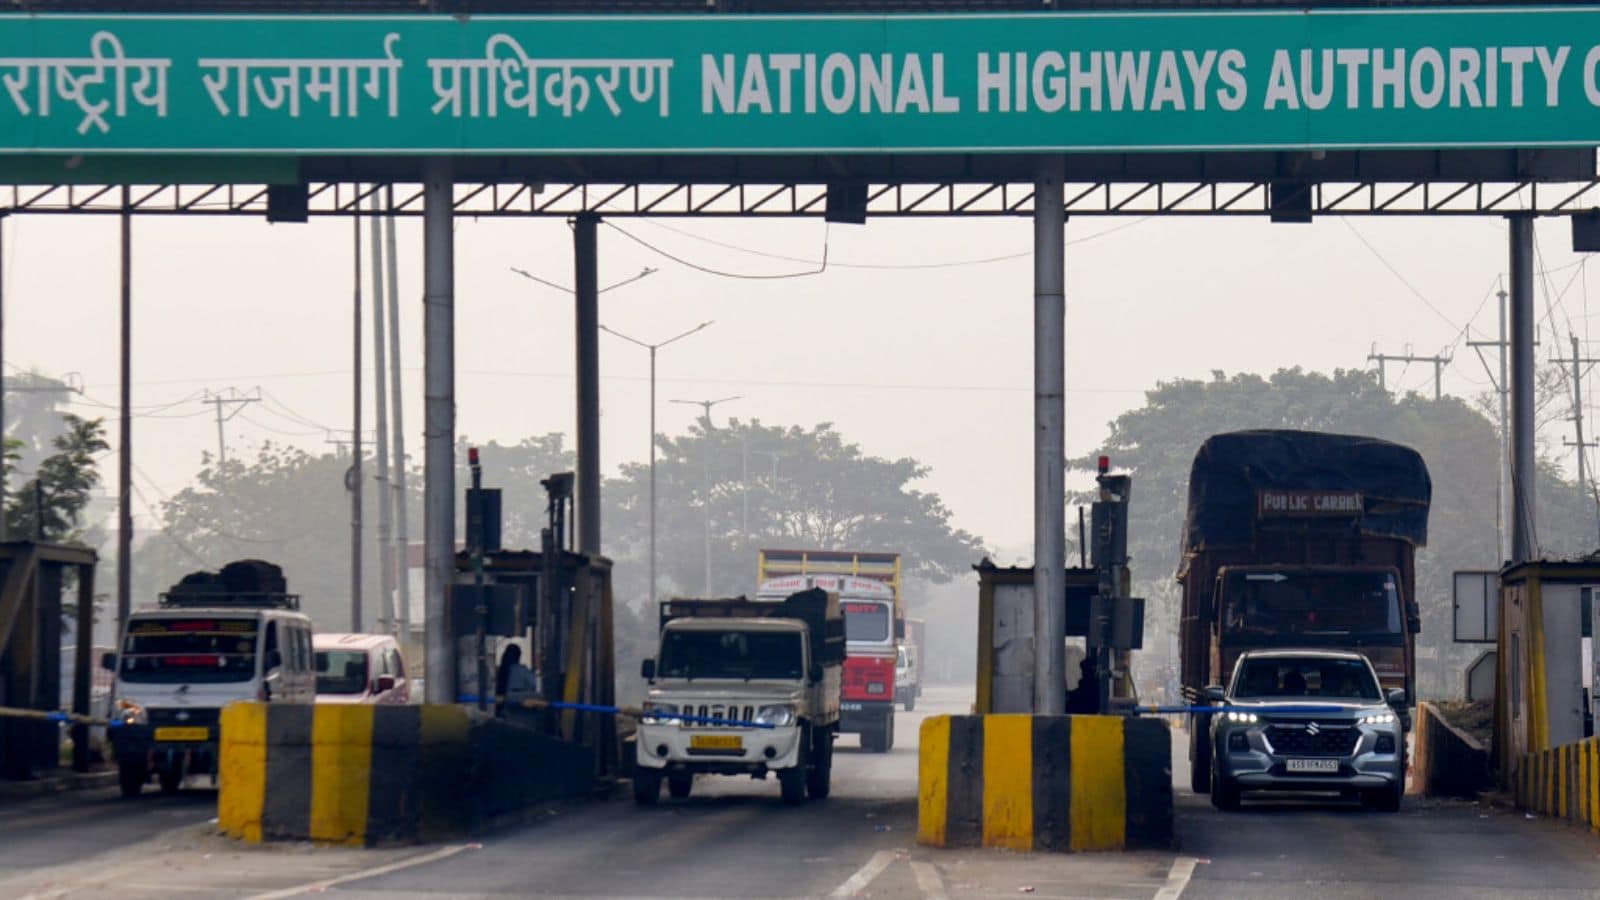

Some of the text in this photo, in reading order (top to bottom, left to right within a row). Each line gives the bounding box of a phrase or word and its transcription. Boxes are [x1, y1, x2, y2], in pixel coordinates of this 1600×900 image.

[0, 32, 673, 133] राष्ट्रीय राजमार्ग प्राधिकरण
[702, 53, 959, 113] NATIONAL
[978, 50, 1247, 112] HIGHWAYS
[1264, 47, 1570, 109] AUTHORITY
[1264, 493, 1308, 511] PUBLIC
